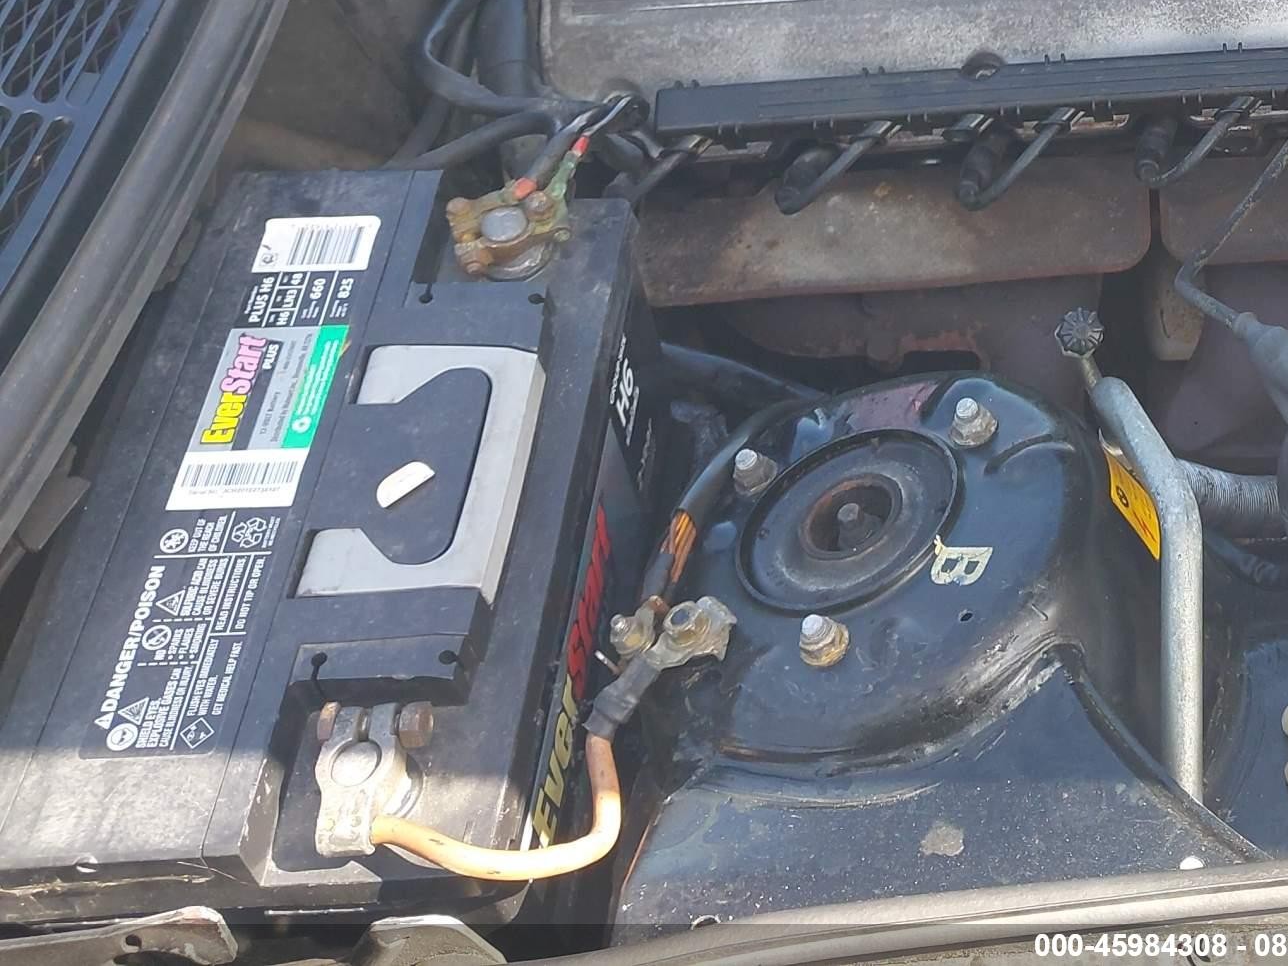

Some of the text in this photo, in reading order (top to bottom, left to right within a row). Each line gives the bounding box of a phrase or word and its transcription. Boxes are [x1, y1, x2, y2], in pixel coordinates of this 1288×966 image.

[309, 278, 326, 299] 660
[337, 278, 354, 298] 825
[248, 294, 268, 323] PLUS
[259, 277, 275, 293] H6
[276, 311, 290, 325] H6
[262, 344, 279, 369] PLUS
[200, 333, 267, 445] EverStart
[616, 357, 634, 427] H6
[205, 580, 222, 604] SEVERE
[247, 578, 259, 588] OR
[243, 589, 255, 602] TIP
[214, 610, 229, 630] READ
[101, 565, 166, 711] DANGER/POISON
[177, 627, 195, 653] FLAMES
[224, 658, 237, 674] HELP
[193, 679, 206, 694] EYES
[146, 706, 169, 746] EXPLOSIVE
[161, 680, 178, 703] GASES
[186, 695, 201, 716] FLUSH
[197, 698, 211, 715] WITH
